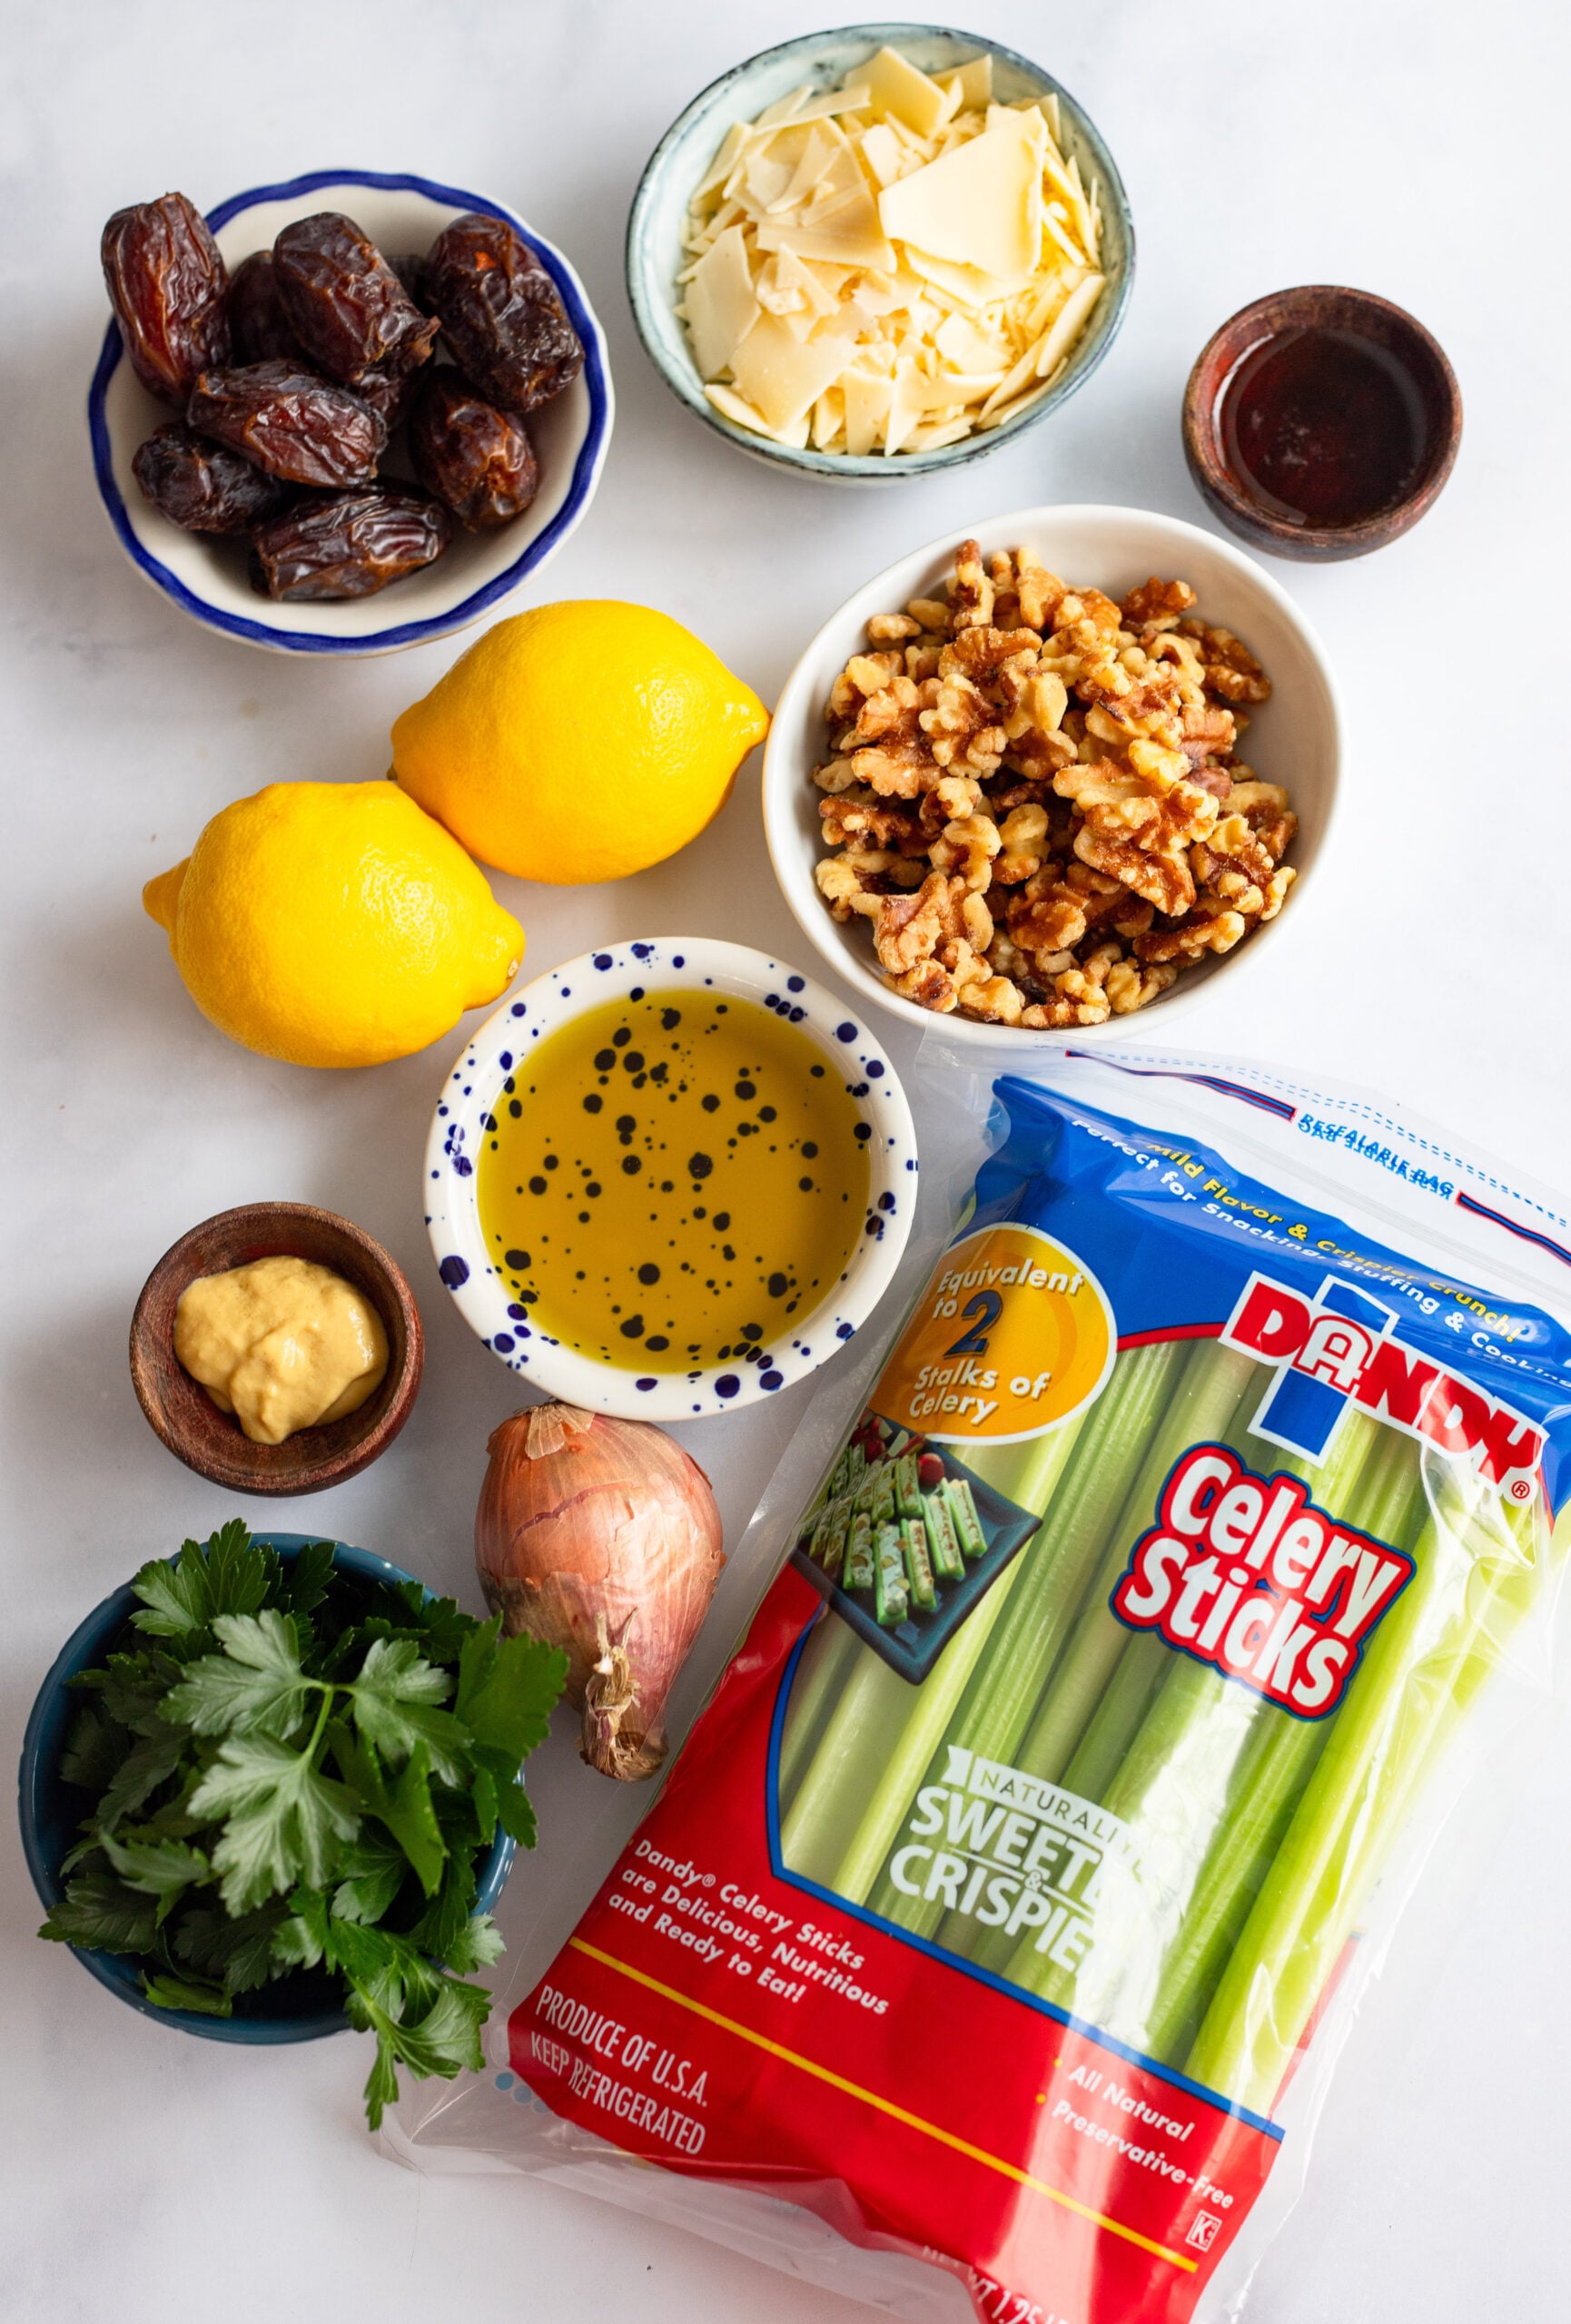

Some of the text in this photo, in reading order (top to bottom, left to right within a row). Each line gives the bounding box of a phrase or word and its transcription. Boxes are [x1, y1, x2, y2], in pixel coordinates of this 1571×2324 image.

[1300, 1113, 1411, 1170] RESEALABLE
[936, 1257, 1084, 1297] Equivalent
[1145, 1144, 1522, 1344] Mild Flavor & Crispier Crunch!
[1160, 1170, 1197, 1203] for
[1201, 1203, 1327, 1259] Snacking,
[1337, 1259, 1441, 1315] Stuffing
[1445, 1312, 1465, 1334] &
[914, 1359, 1052, 1400] Stalks of
[932, 1289, 1003, 1359] to 2
[909, 1386, 999, 1426] Celery
[1226, 1276, 1546, 1487] DANDY
[1169, 1455, 1401, 1640] Celery
[1123, 1536, 1348, 1708] Sticks
[909, 1785, 1104, 1905] SWEET
[980, 1768, 1131, 1855] NATURAL
[608, 1892, 807, 2004] and Ready to Eat!
[622, 1867, 889, 2015] are Delicious, Nutritious
[719, 1883, 794, 1935] Celery
[795, 1922, 865, 1970] Sticks
[889, 1844, 1094, 1973] CRISPIE
[530, 2031, 706, 2155] KEEP REFRIGERATED
[535, 1984, 708, 2108] PRODUCE OF U.S.A.
[1052, 2099, 1234, 2209] Preservative-Free
[1068, 2064, 1195, 2142] All Natural
[967, 2266, 998, 2304] WT
